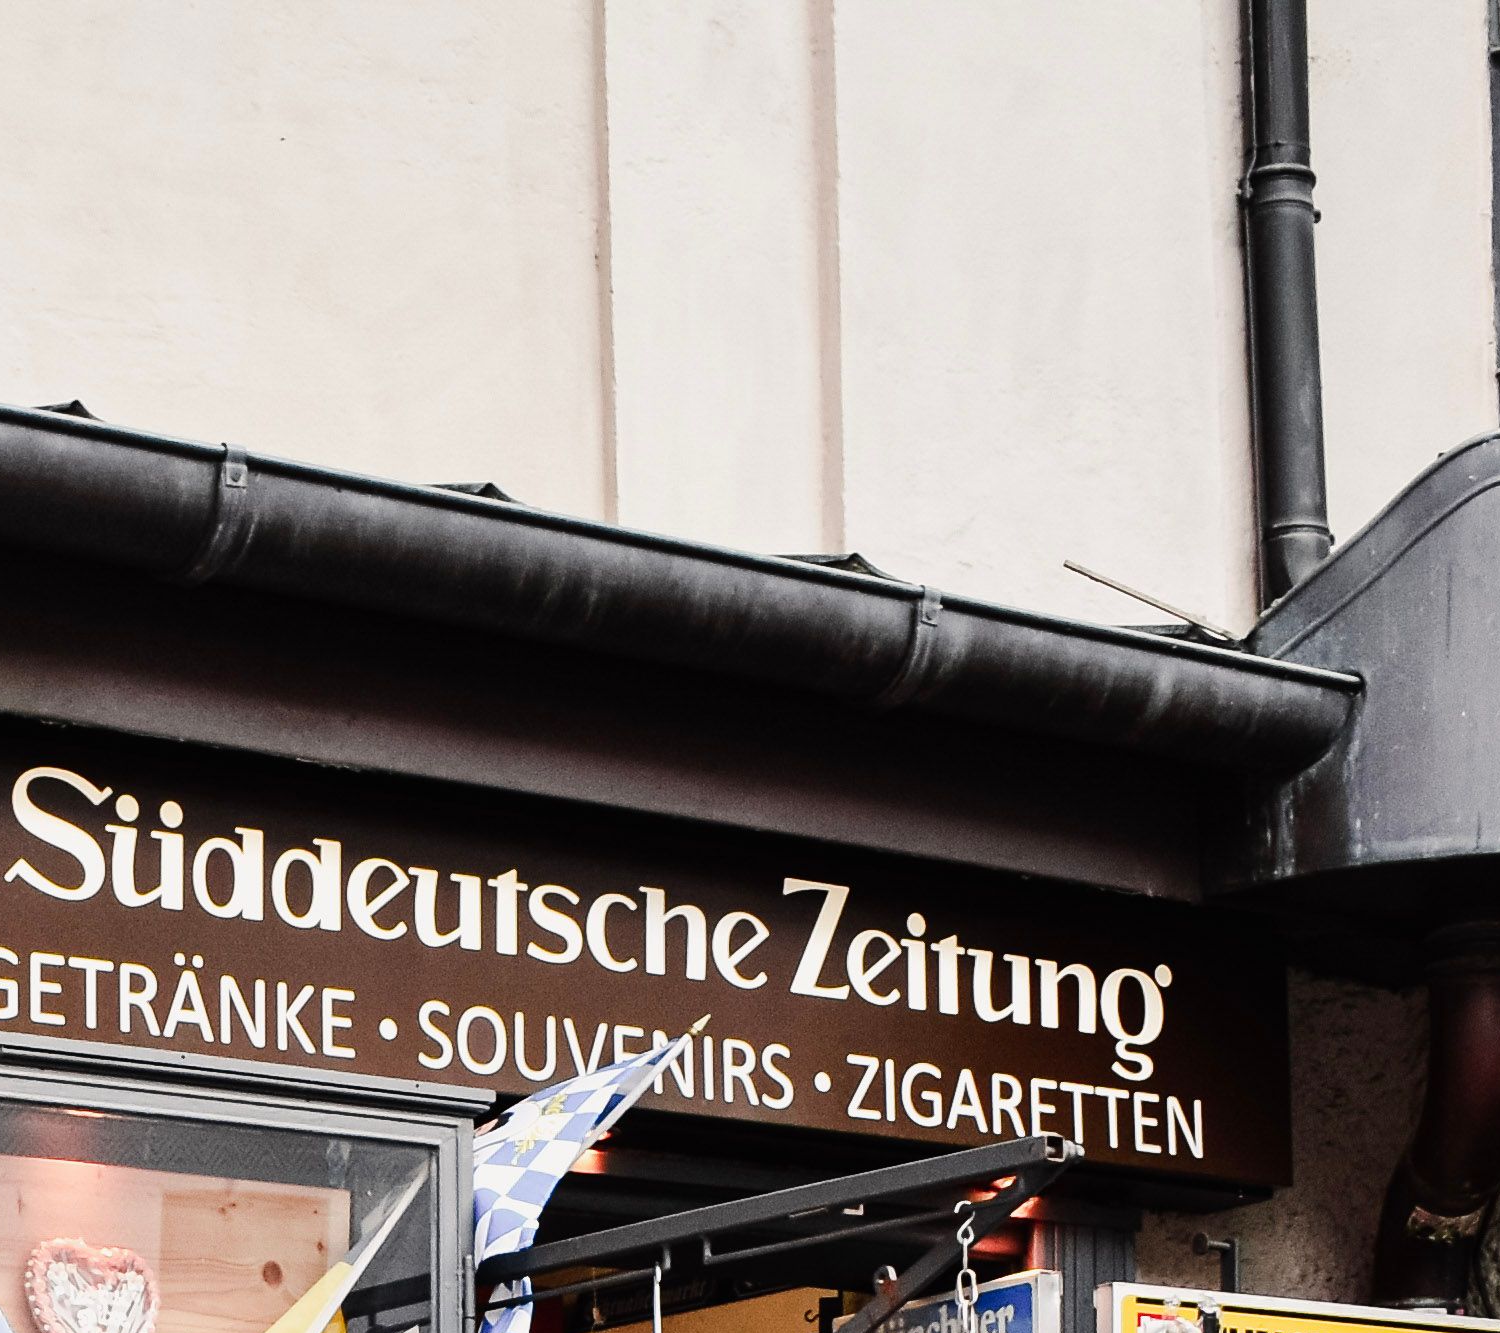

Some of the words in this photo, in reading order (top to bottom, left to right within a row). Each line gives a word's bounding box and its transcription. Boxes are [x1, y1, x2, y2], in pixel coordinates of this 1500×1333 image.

[4, 766, 770, 991] Süddeutsche
[781, 878, 1172, 1081] Zeitung
[847, 1055, 1204, 1159] ZIGARETTEN
